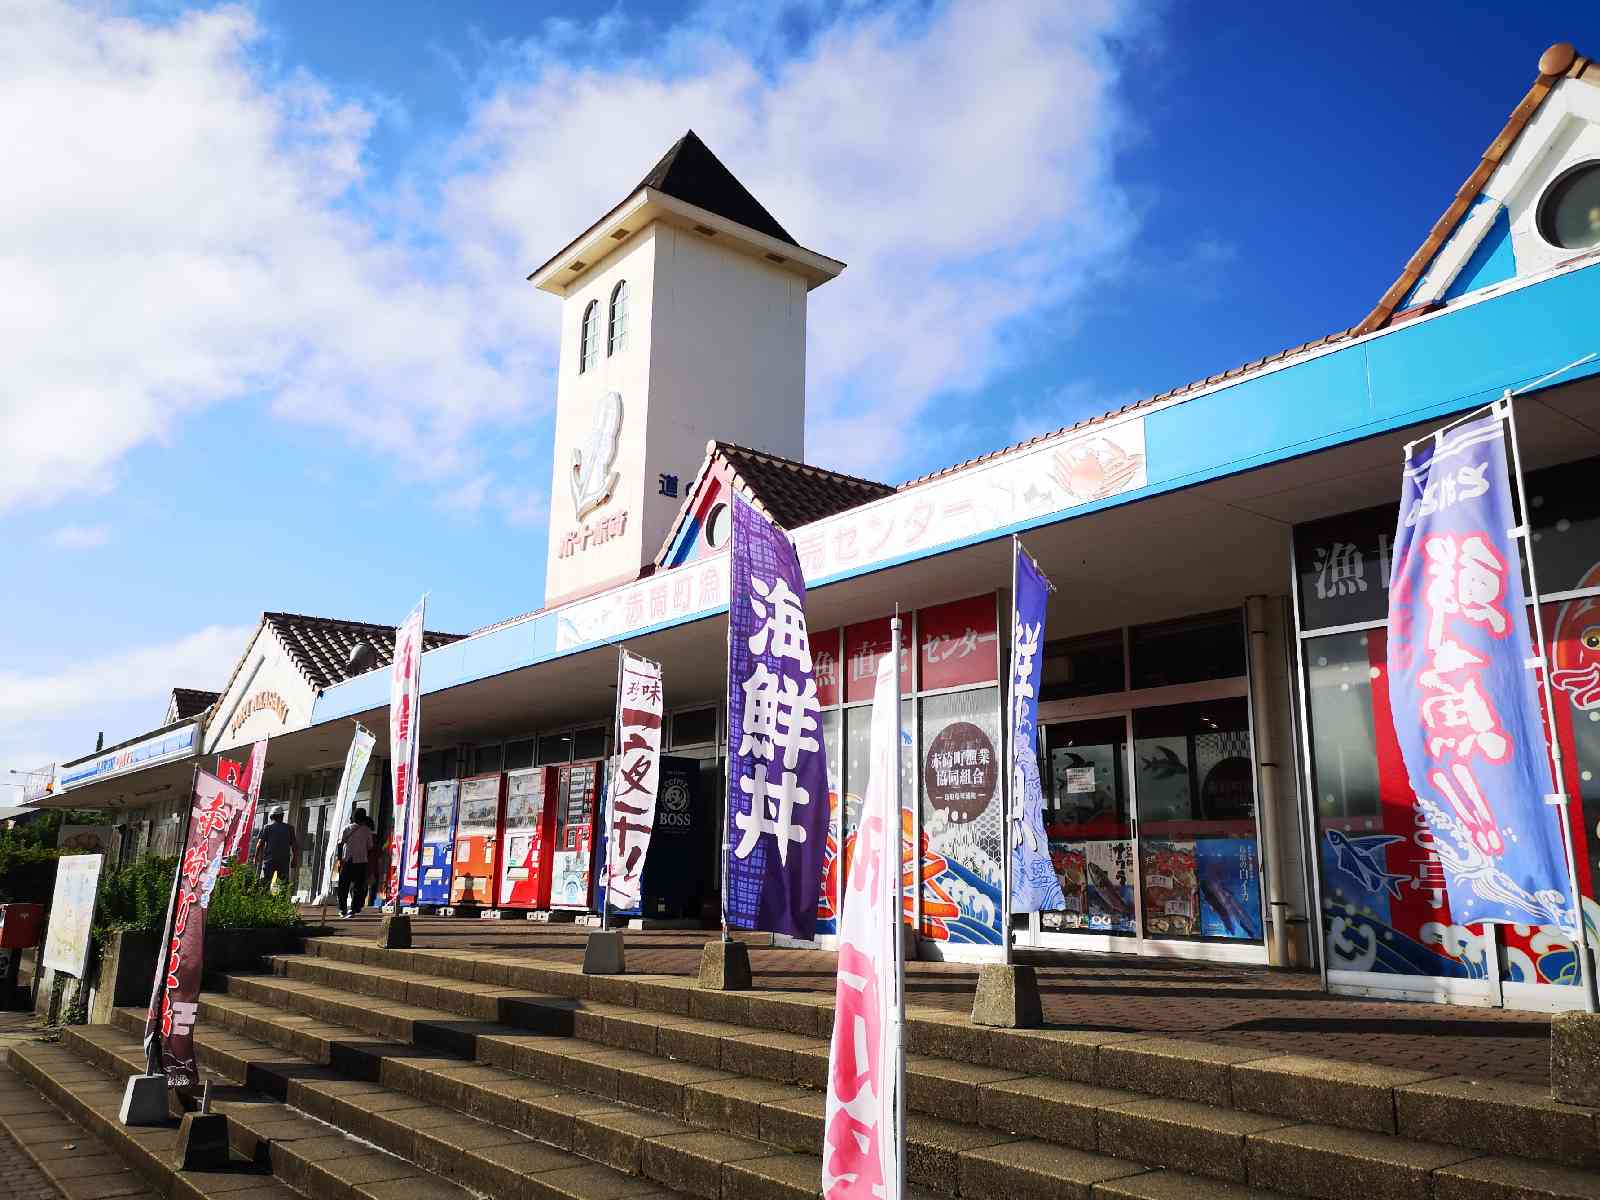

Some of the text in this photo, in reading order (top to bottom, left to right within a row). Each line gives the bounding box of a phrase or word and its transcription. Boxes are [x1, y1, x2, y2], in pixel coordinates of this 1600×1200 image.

[626, 681, 662, 706] 珍味
[734, 576, 821, 867] 海鮮丼
[936, 767, 985, 787] 協同組合
[659, 812, 691, 826] BOSS
